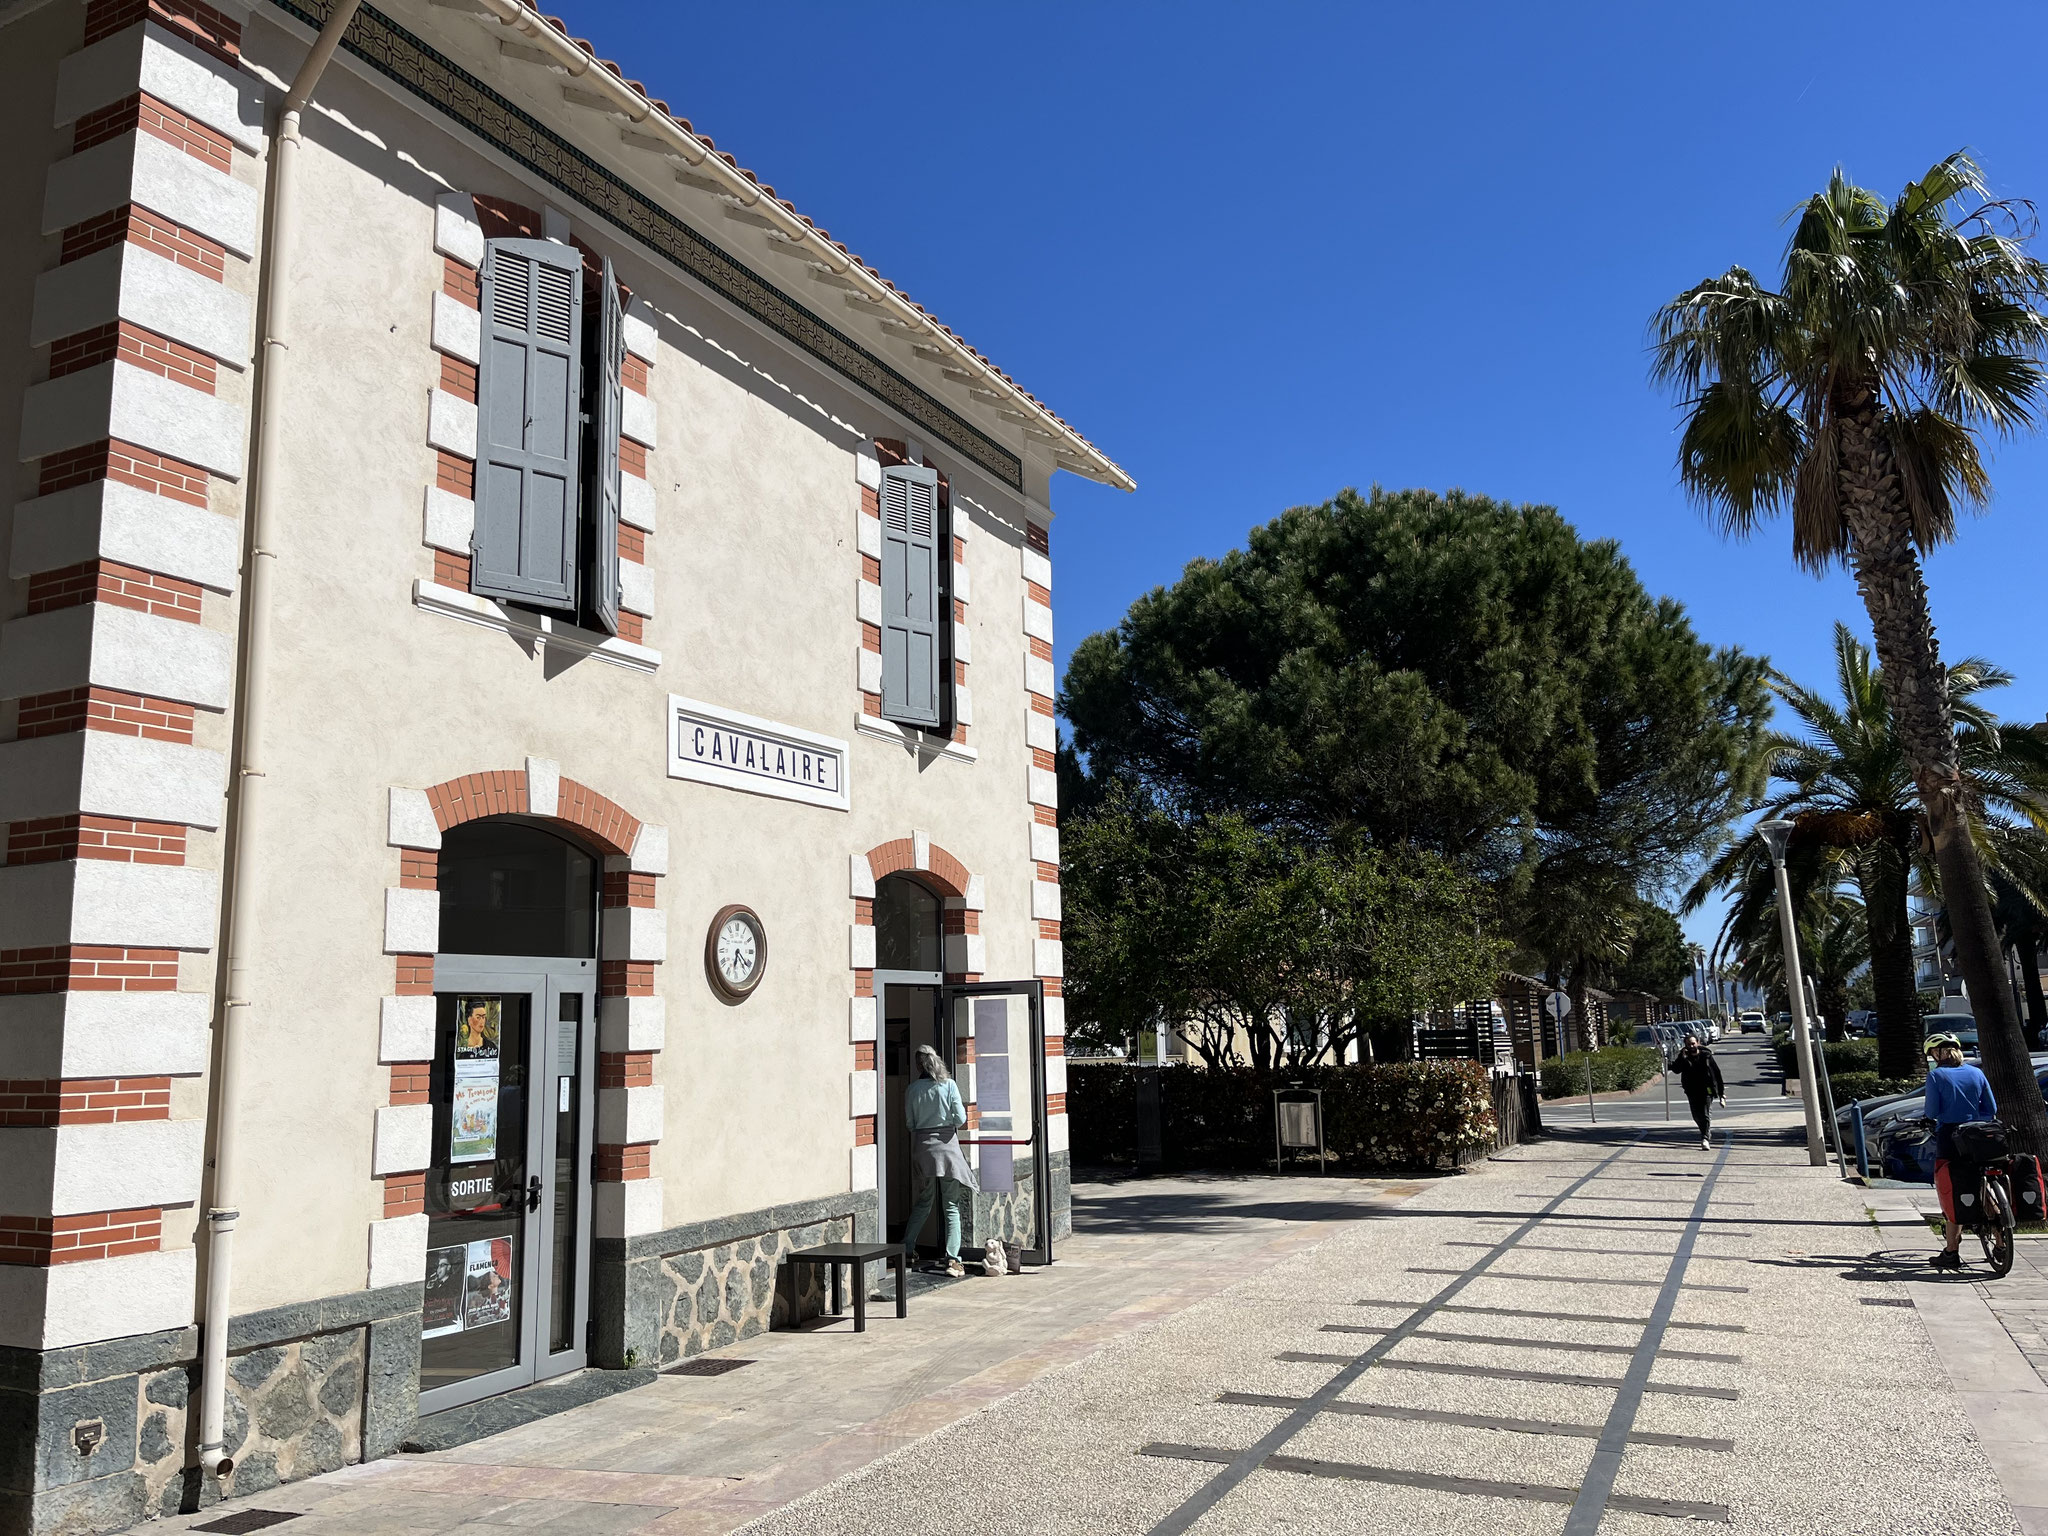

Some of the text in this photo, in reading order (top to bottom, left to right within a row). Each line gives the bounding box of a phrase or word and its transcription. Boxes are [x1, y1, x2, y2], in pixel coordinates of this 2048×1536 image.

[694, 727, 825, 784] CAVALAIRE
[451, 1177, 493, 1197] SORTIE
[470, 1260, 498, 1271] FLAMENCO
